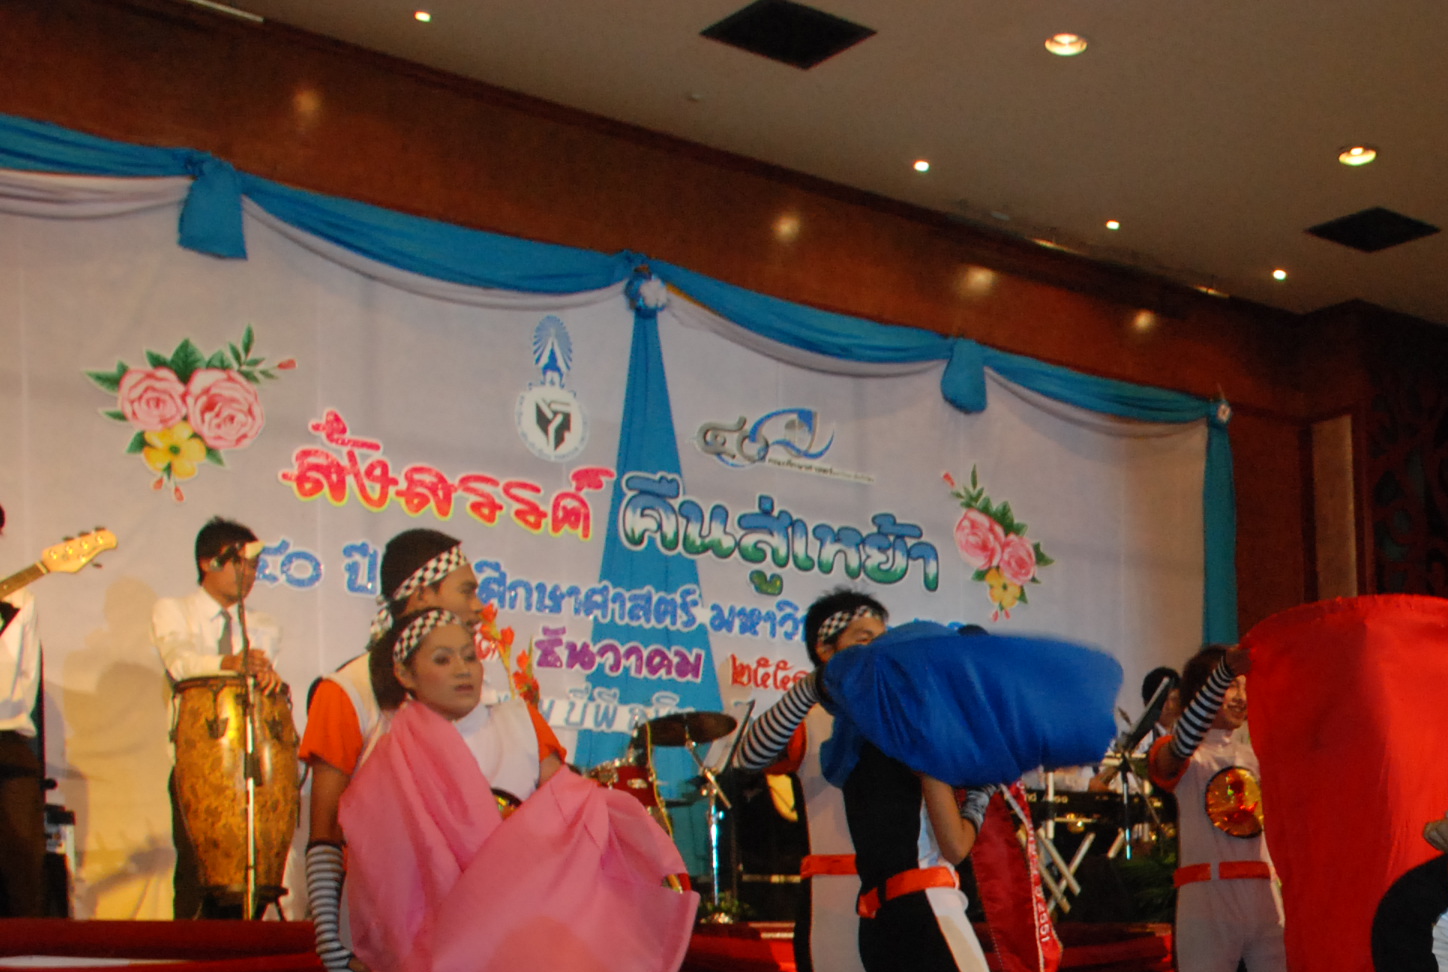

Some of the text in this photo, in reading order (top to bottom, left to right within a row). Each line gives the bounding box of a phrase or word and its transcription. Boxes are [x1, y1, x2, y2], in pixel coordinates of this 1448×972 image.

[622, 474, 938, 595] คืนสู่เหย้า
[343, 541, 378, 595] ปี
[710, 599, 806, 642] มหาวิ
[534, 625, 703, 681] ธันวาคม
